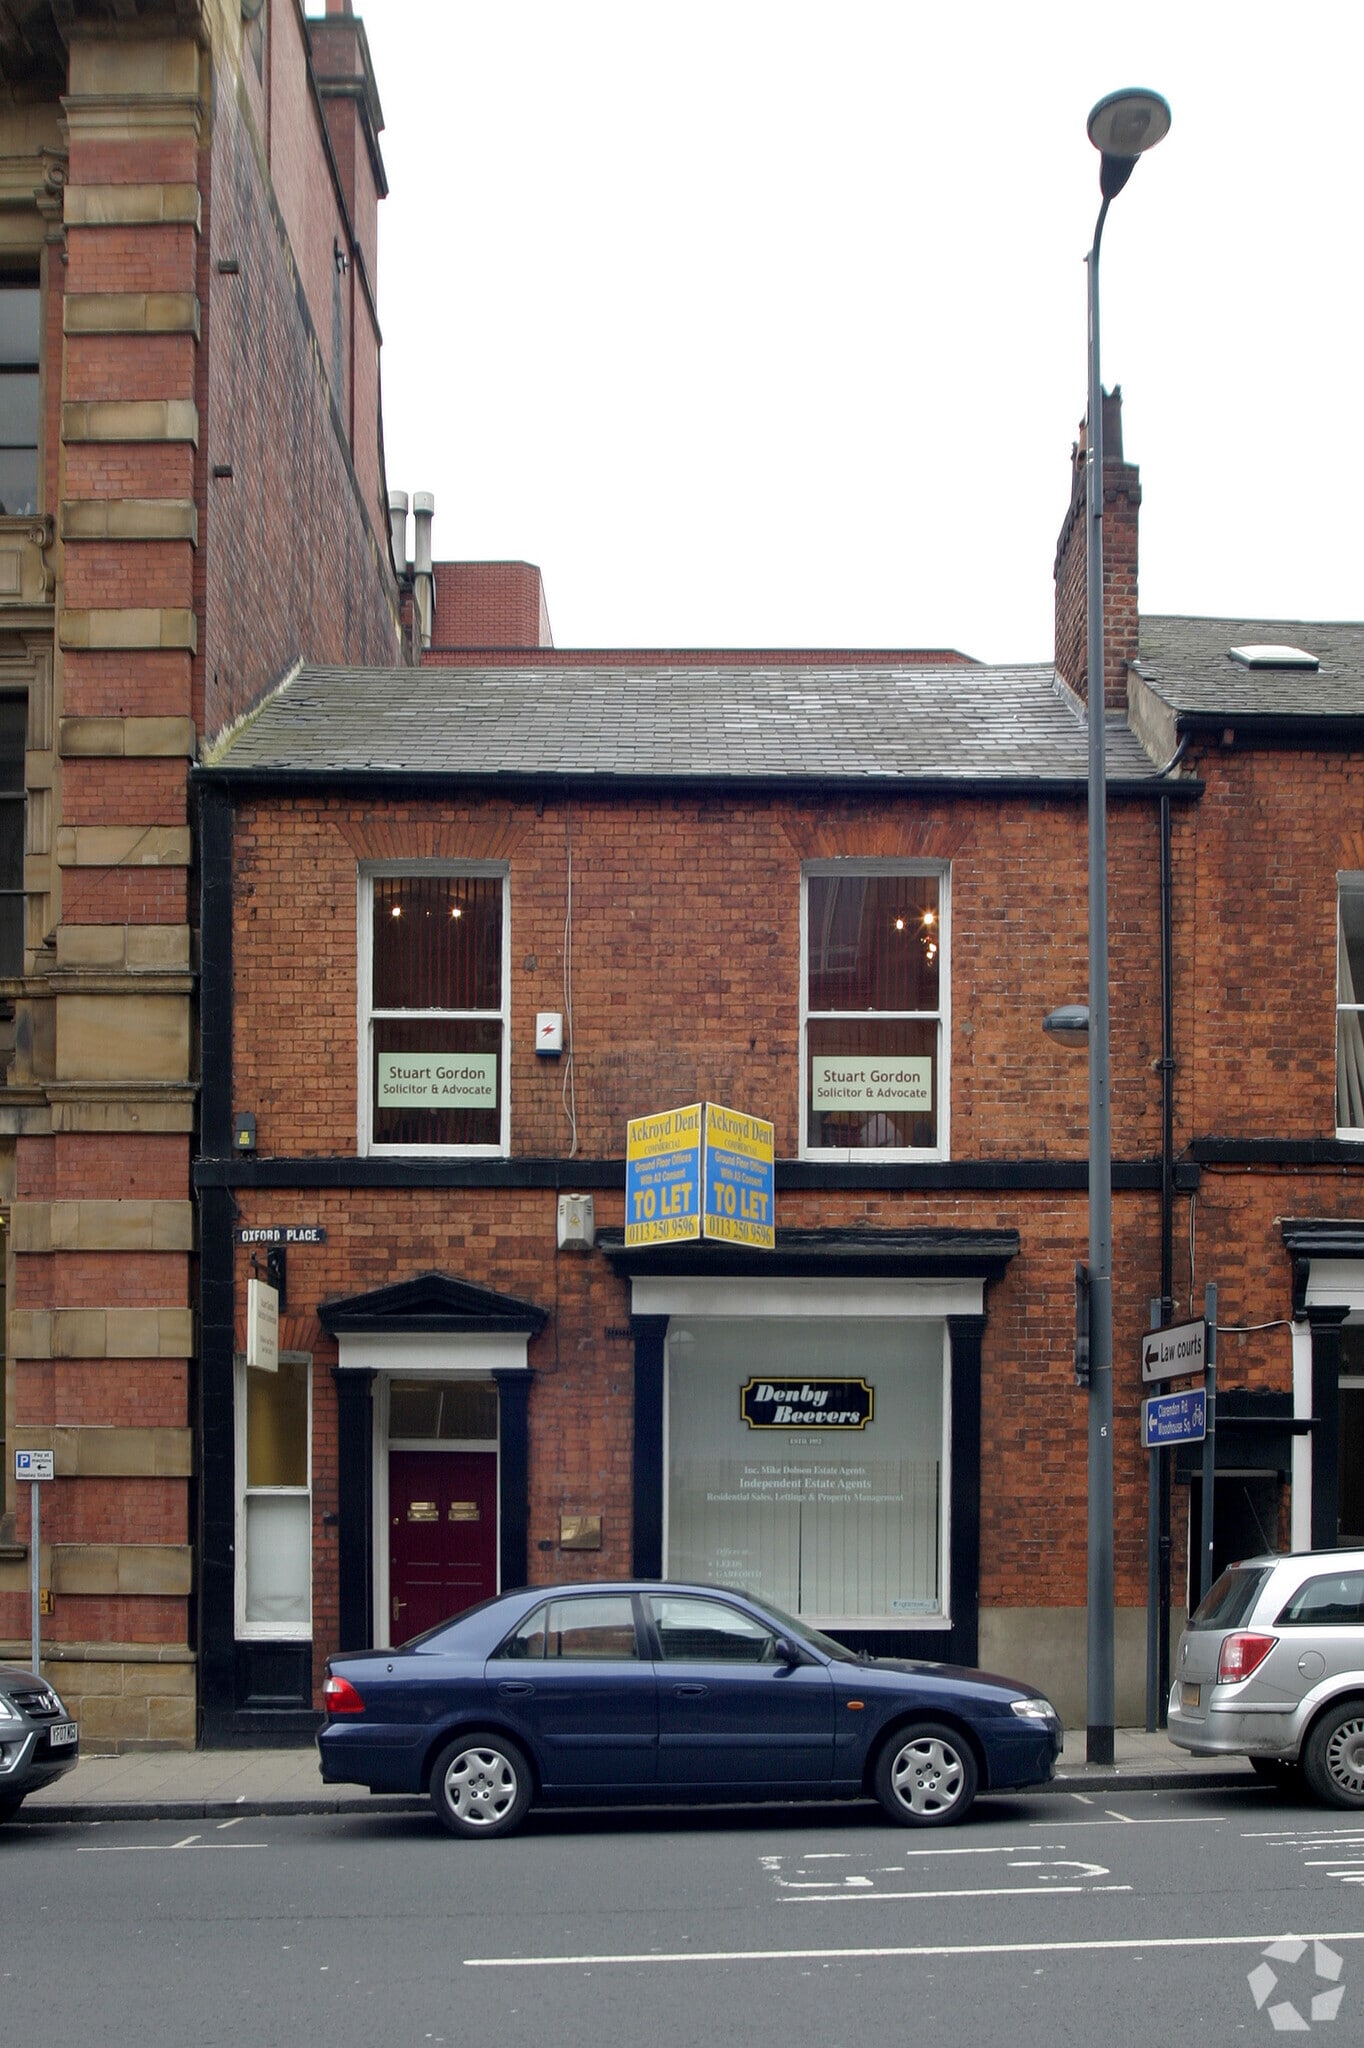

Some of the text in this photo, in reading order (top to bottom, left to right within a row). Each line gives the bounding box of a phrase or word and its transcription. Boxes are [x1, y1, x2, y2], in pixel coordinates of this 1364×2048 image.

[389, 1066, 486, 1079] Stuart Gordon
[823, 1069, 921, 1083] Stuart Gordon
[383, 1083, 492, 1095] Solicitor & Advocate
[817, 1087, 927, 1099] Solicitor & Advocate
[630, 1112, 700, 1142] Ackroyd Dent
[709, 1110, 772, 1146] Ackroyd Dent
[634, 1182, 692, 1219] TO LET
[713, 1181, 769, 1221] TO LET
[241, 1230, 281, 1242] OXFORD
[629, 1217, 695, 1242] 0113 250 9596
[709, 1218, 771, 1244] 0113 250 9596
[1160, 1334, 1202, 1362] Law courts
[754, 1384, 829, 1407] Denby
[772, 1405, 860, 1424] Beevers
[1157, 1403, 1180, 1418] Clarendon
[1100, 1427, 1107, 1437] 5
[1157, 1421, 1183, 1436] Woodhouse
[20, 1455, 29, 1467] P
[762, 1466, 781, 1474] Mike
[814, 1466, 838, 1474] Estate
[839, 1466, 866, 1476] Agents
[740, 1478, 872, 1490] Independent Estate Agents
[707, 1492, 750, 1501] Residential
[775, 1492, 806, 1502] Lettings
[809, 1493, 814, 1501] &
[817, 1492, 851, 1503] Property
[852, 1493, 904, 1503] Management
